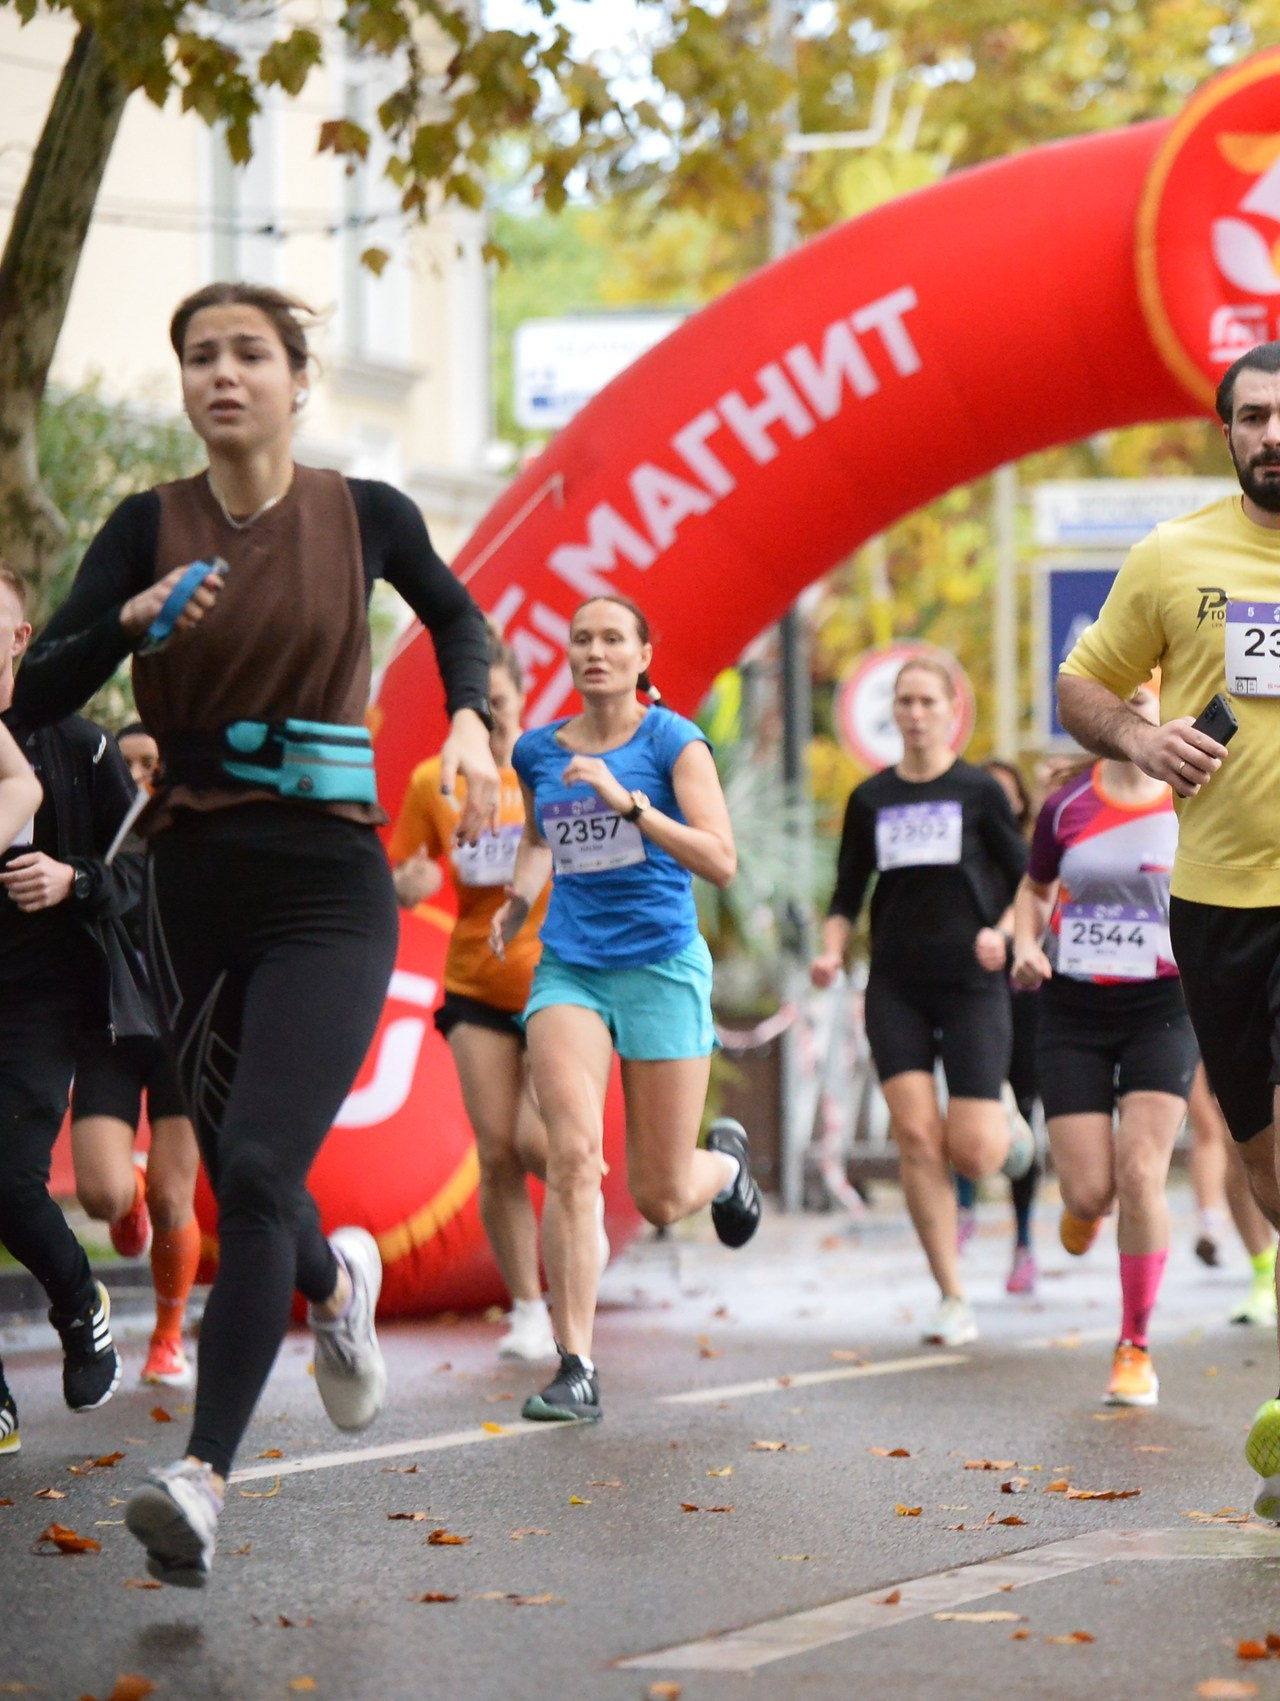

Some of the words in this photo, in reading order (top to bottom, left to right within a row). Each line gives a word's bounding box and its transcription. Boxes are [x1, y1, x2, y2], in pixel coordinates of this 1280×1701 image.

[546, 285, 923, 602] МАГНИТ
[556, 815, 622, 845] 2357
[1071, 922, 1147, 949] 2544
